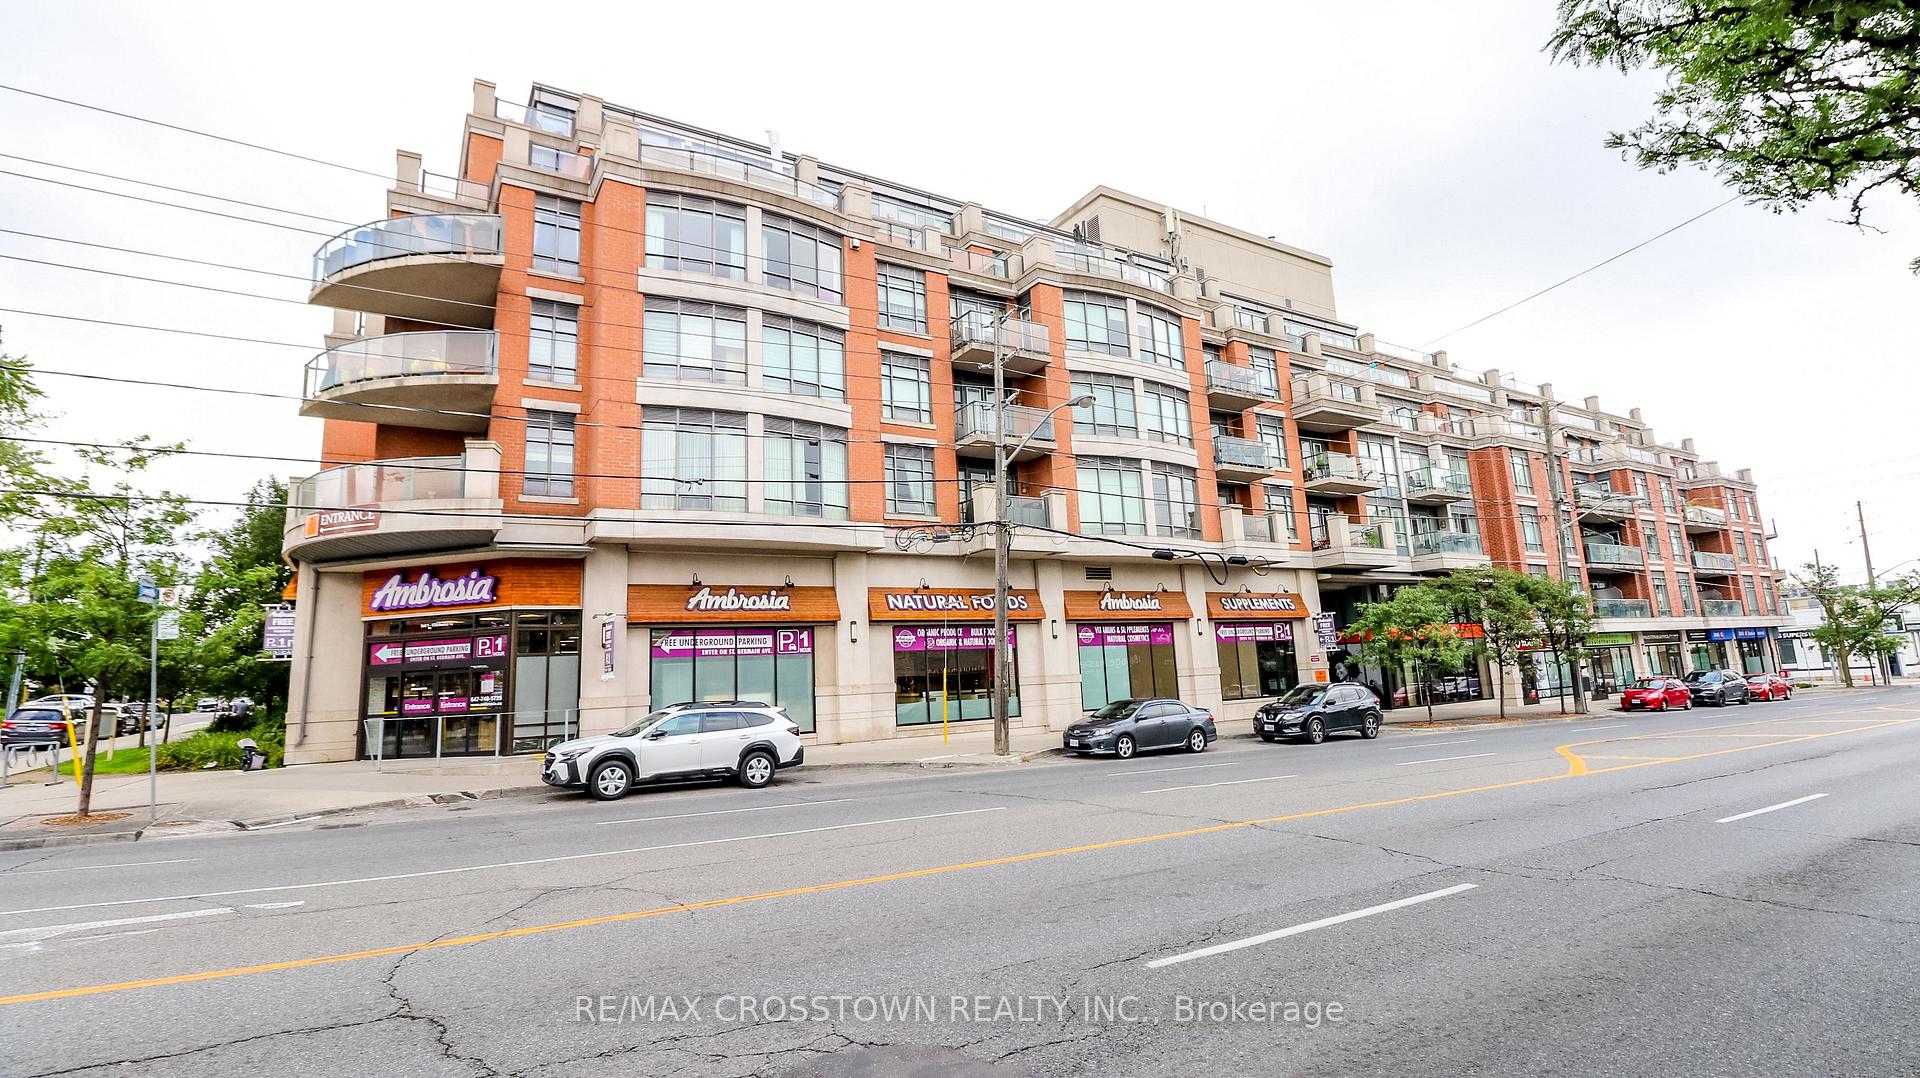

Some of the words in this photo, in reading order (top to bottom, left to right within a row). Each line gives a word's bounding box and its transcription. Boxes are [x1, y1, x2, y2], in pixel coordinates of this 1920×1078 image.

[320, 510, 375, 525] ENTRANCE
[371, 571, 491, 608] Ambrosia
[687, 587, 790, 609] Ambrosia
[887, 594, 968, 609] NATURAL
[971, 596, 1028, 609] FODS
[1100, 592, 1161, 610] Ambrosia
[1221, 598, 1295, 610] SUPPLEMENTS
[495, 637, 503, 652] 1
[679, 637, 734, 647] UNDERGROUND
[738, 637, 768, 645] PARKING
[800, 631, 809, 647] 1
[406, 647, 445, 655] UNDERGROUND
[446, 645, 469, 653] PARKING
[404, 703, 431, 711] Entrance
[440, 701, 467, 709] Entrance
